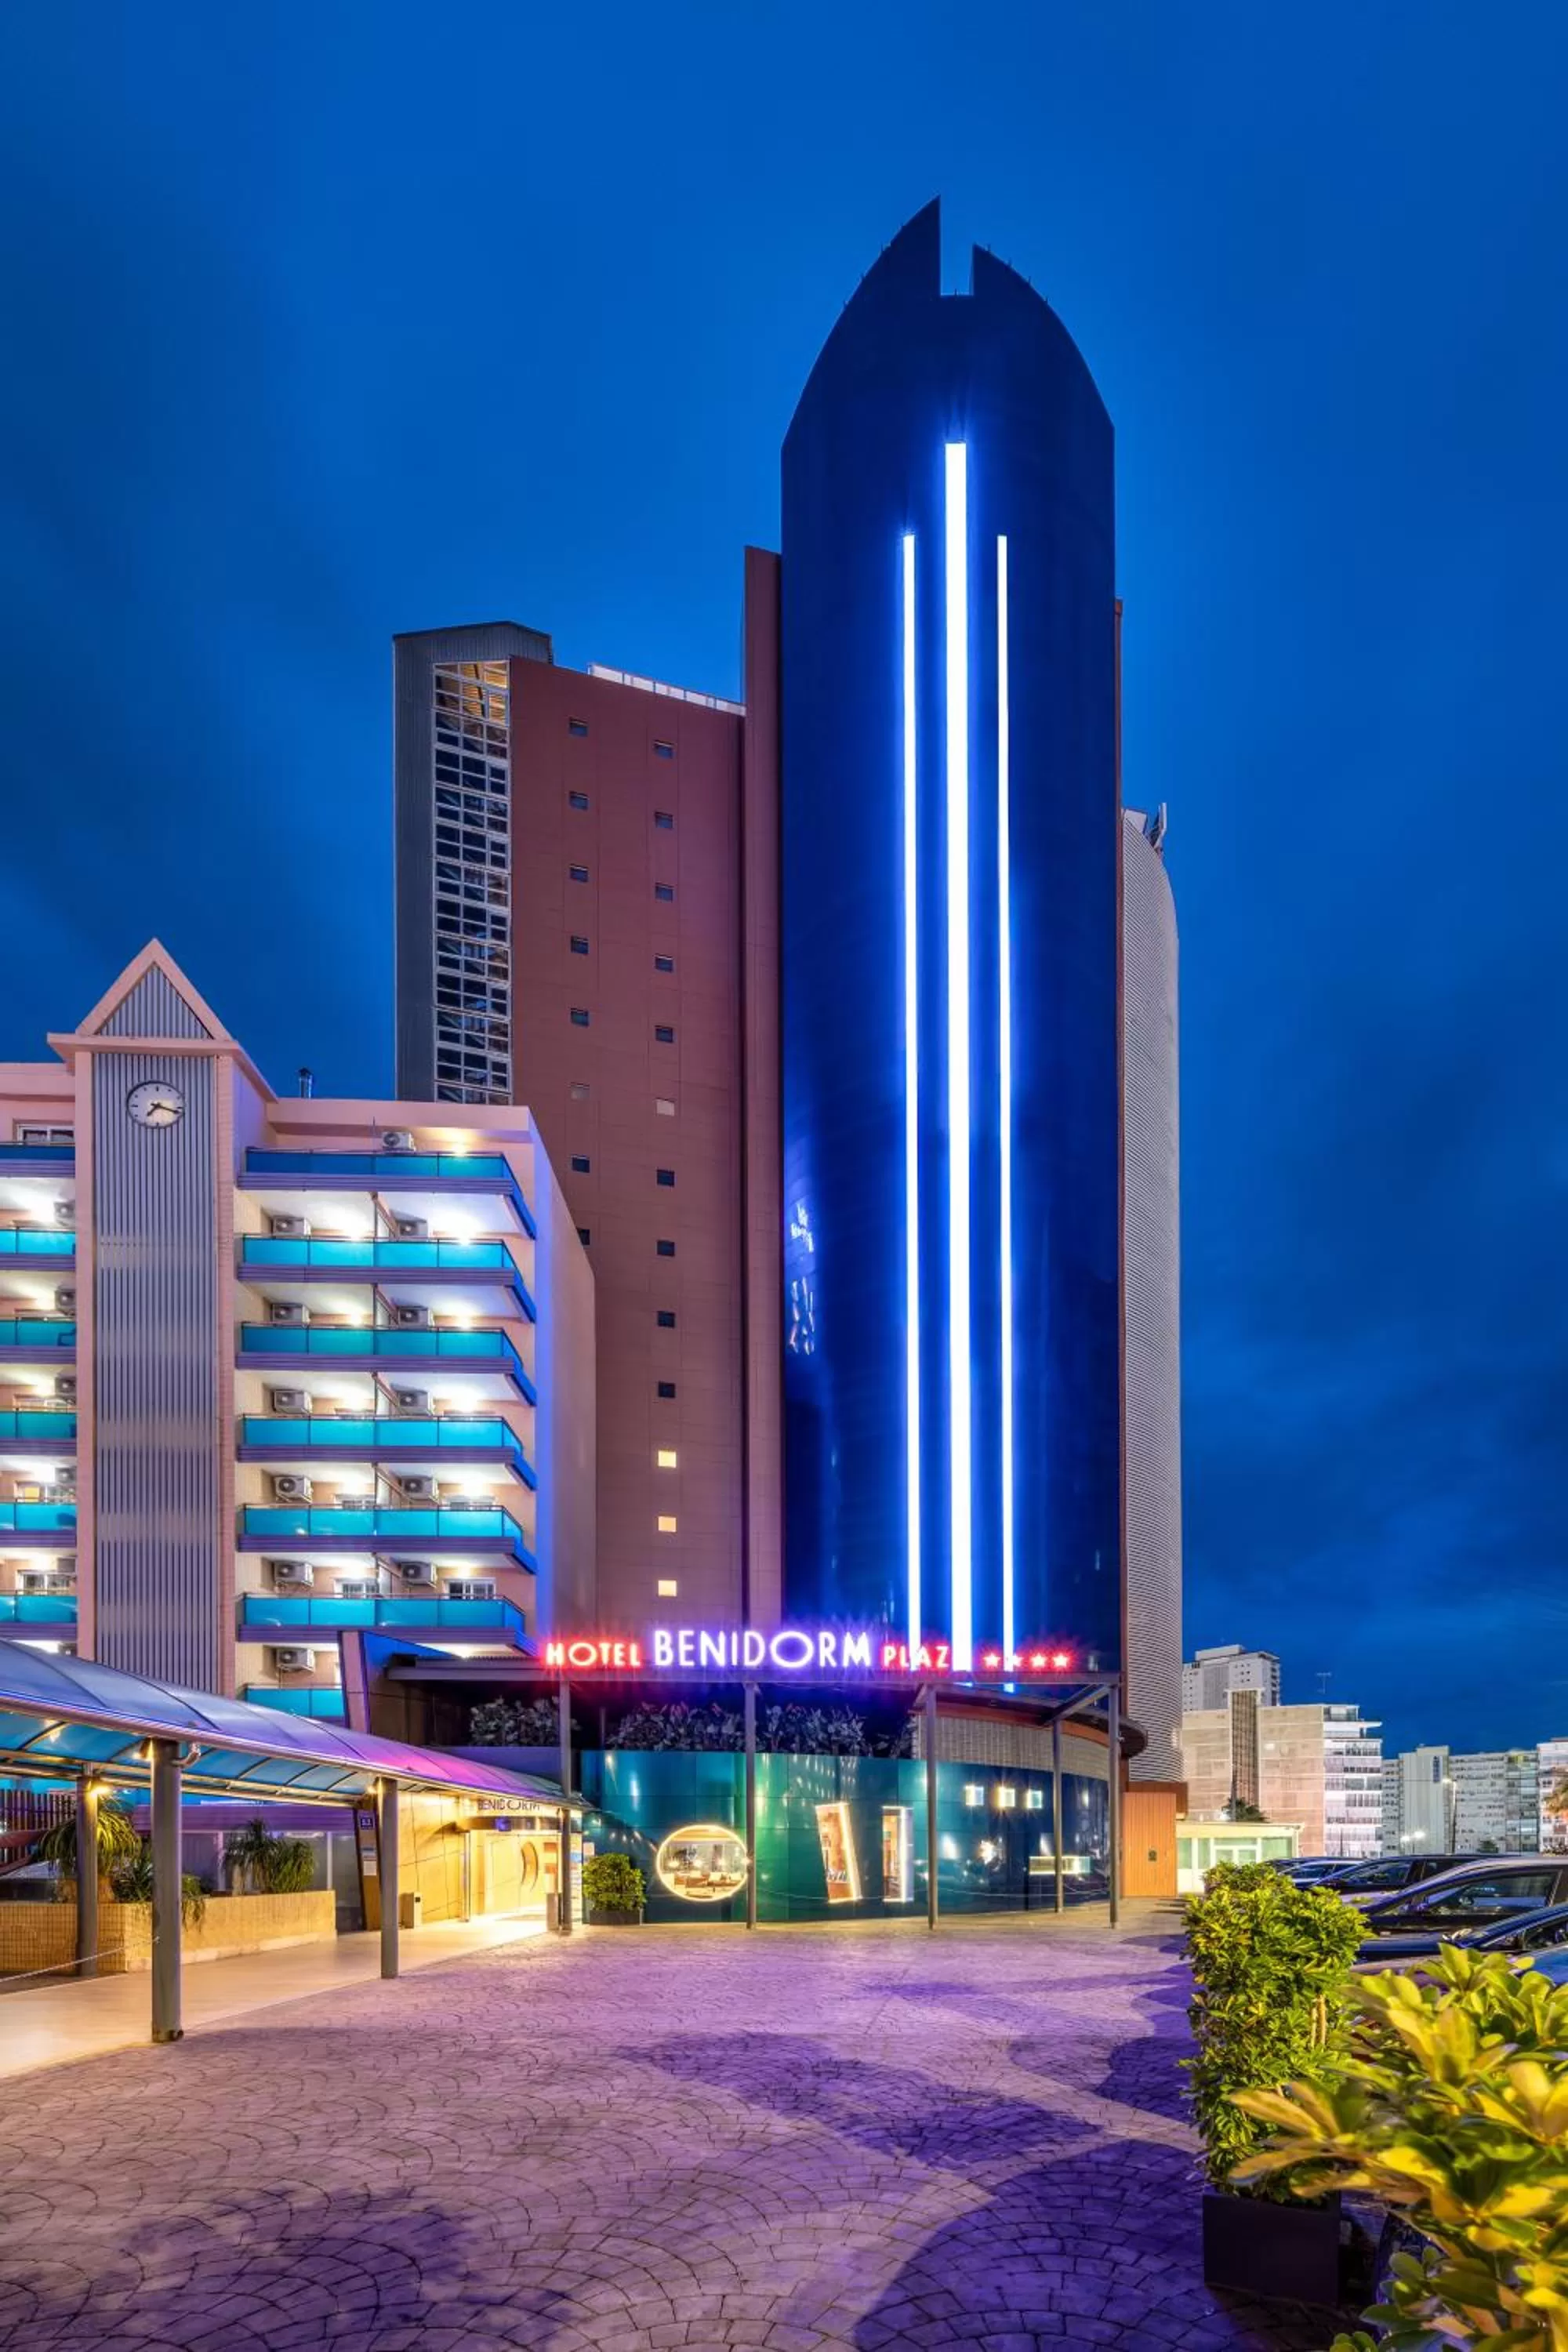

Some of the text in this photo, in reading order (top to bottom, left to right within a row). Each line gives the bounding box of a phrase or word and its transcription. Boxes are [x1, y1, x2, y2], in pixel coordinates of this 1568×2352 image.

[546, 1629, 972, 1668] HOTEL BENIDORM PLAZ
